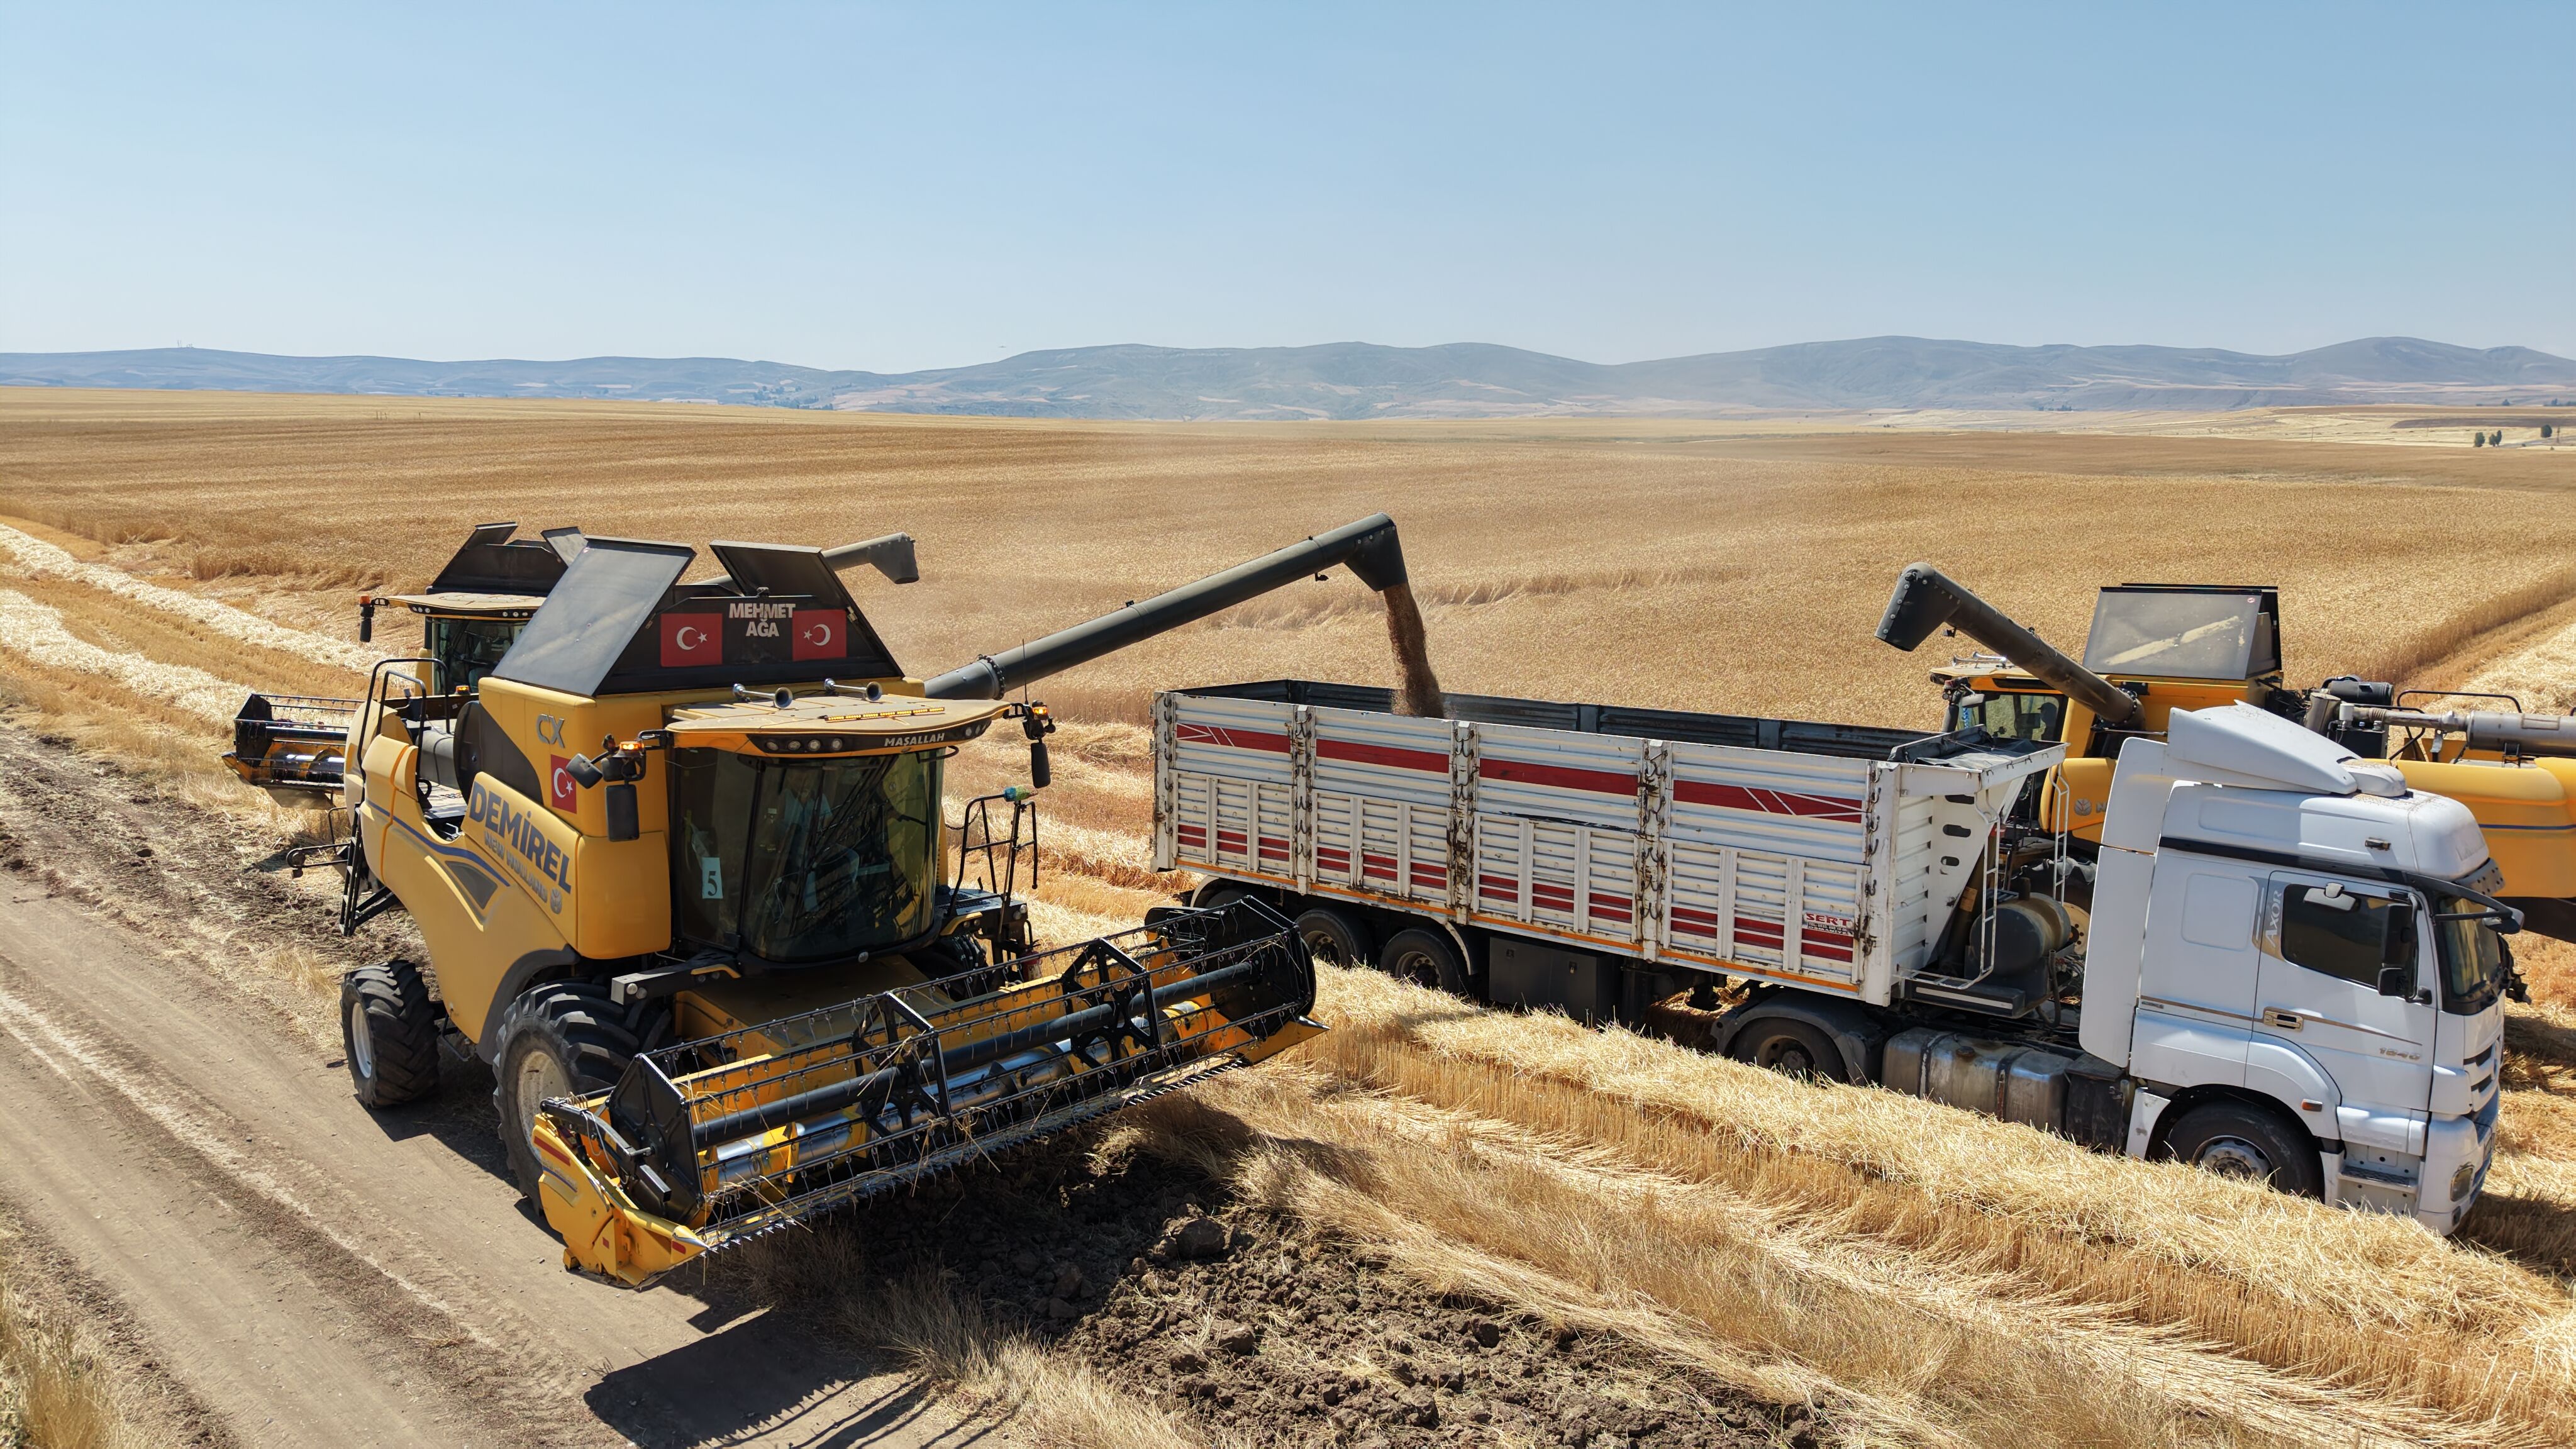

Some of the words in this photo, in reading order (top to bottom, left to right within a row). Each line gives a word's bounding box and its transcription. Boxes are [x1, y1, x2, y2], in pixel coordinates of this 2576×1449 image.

[729, 603, 796, 618] MEHMET
[745, 618, 780, 637] AĞA
[536, 714, 565, 748] CX
[469, 781, 572, 894] DEMİREL
[484, 830, 504, 860] NEW
[708, 870, 718, 896] 5
[1806, 913, 1850, 926] SERT
